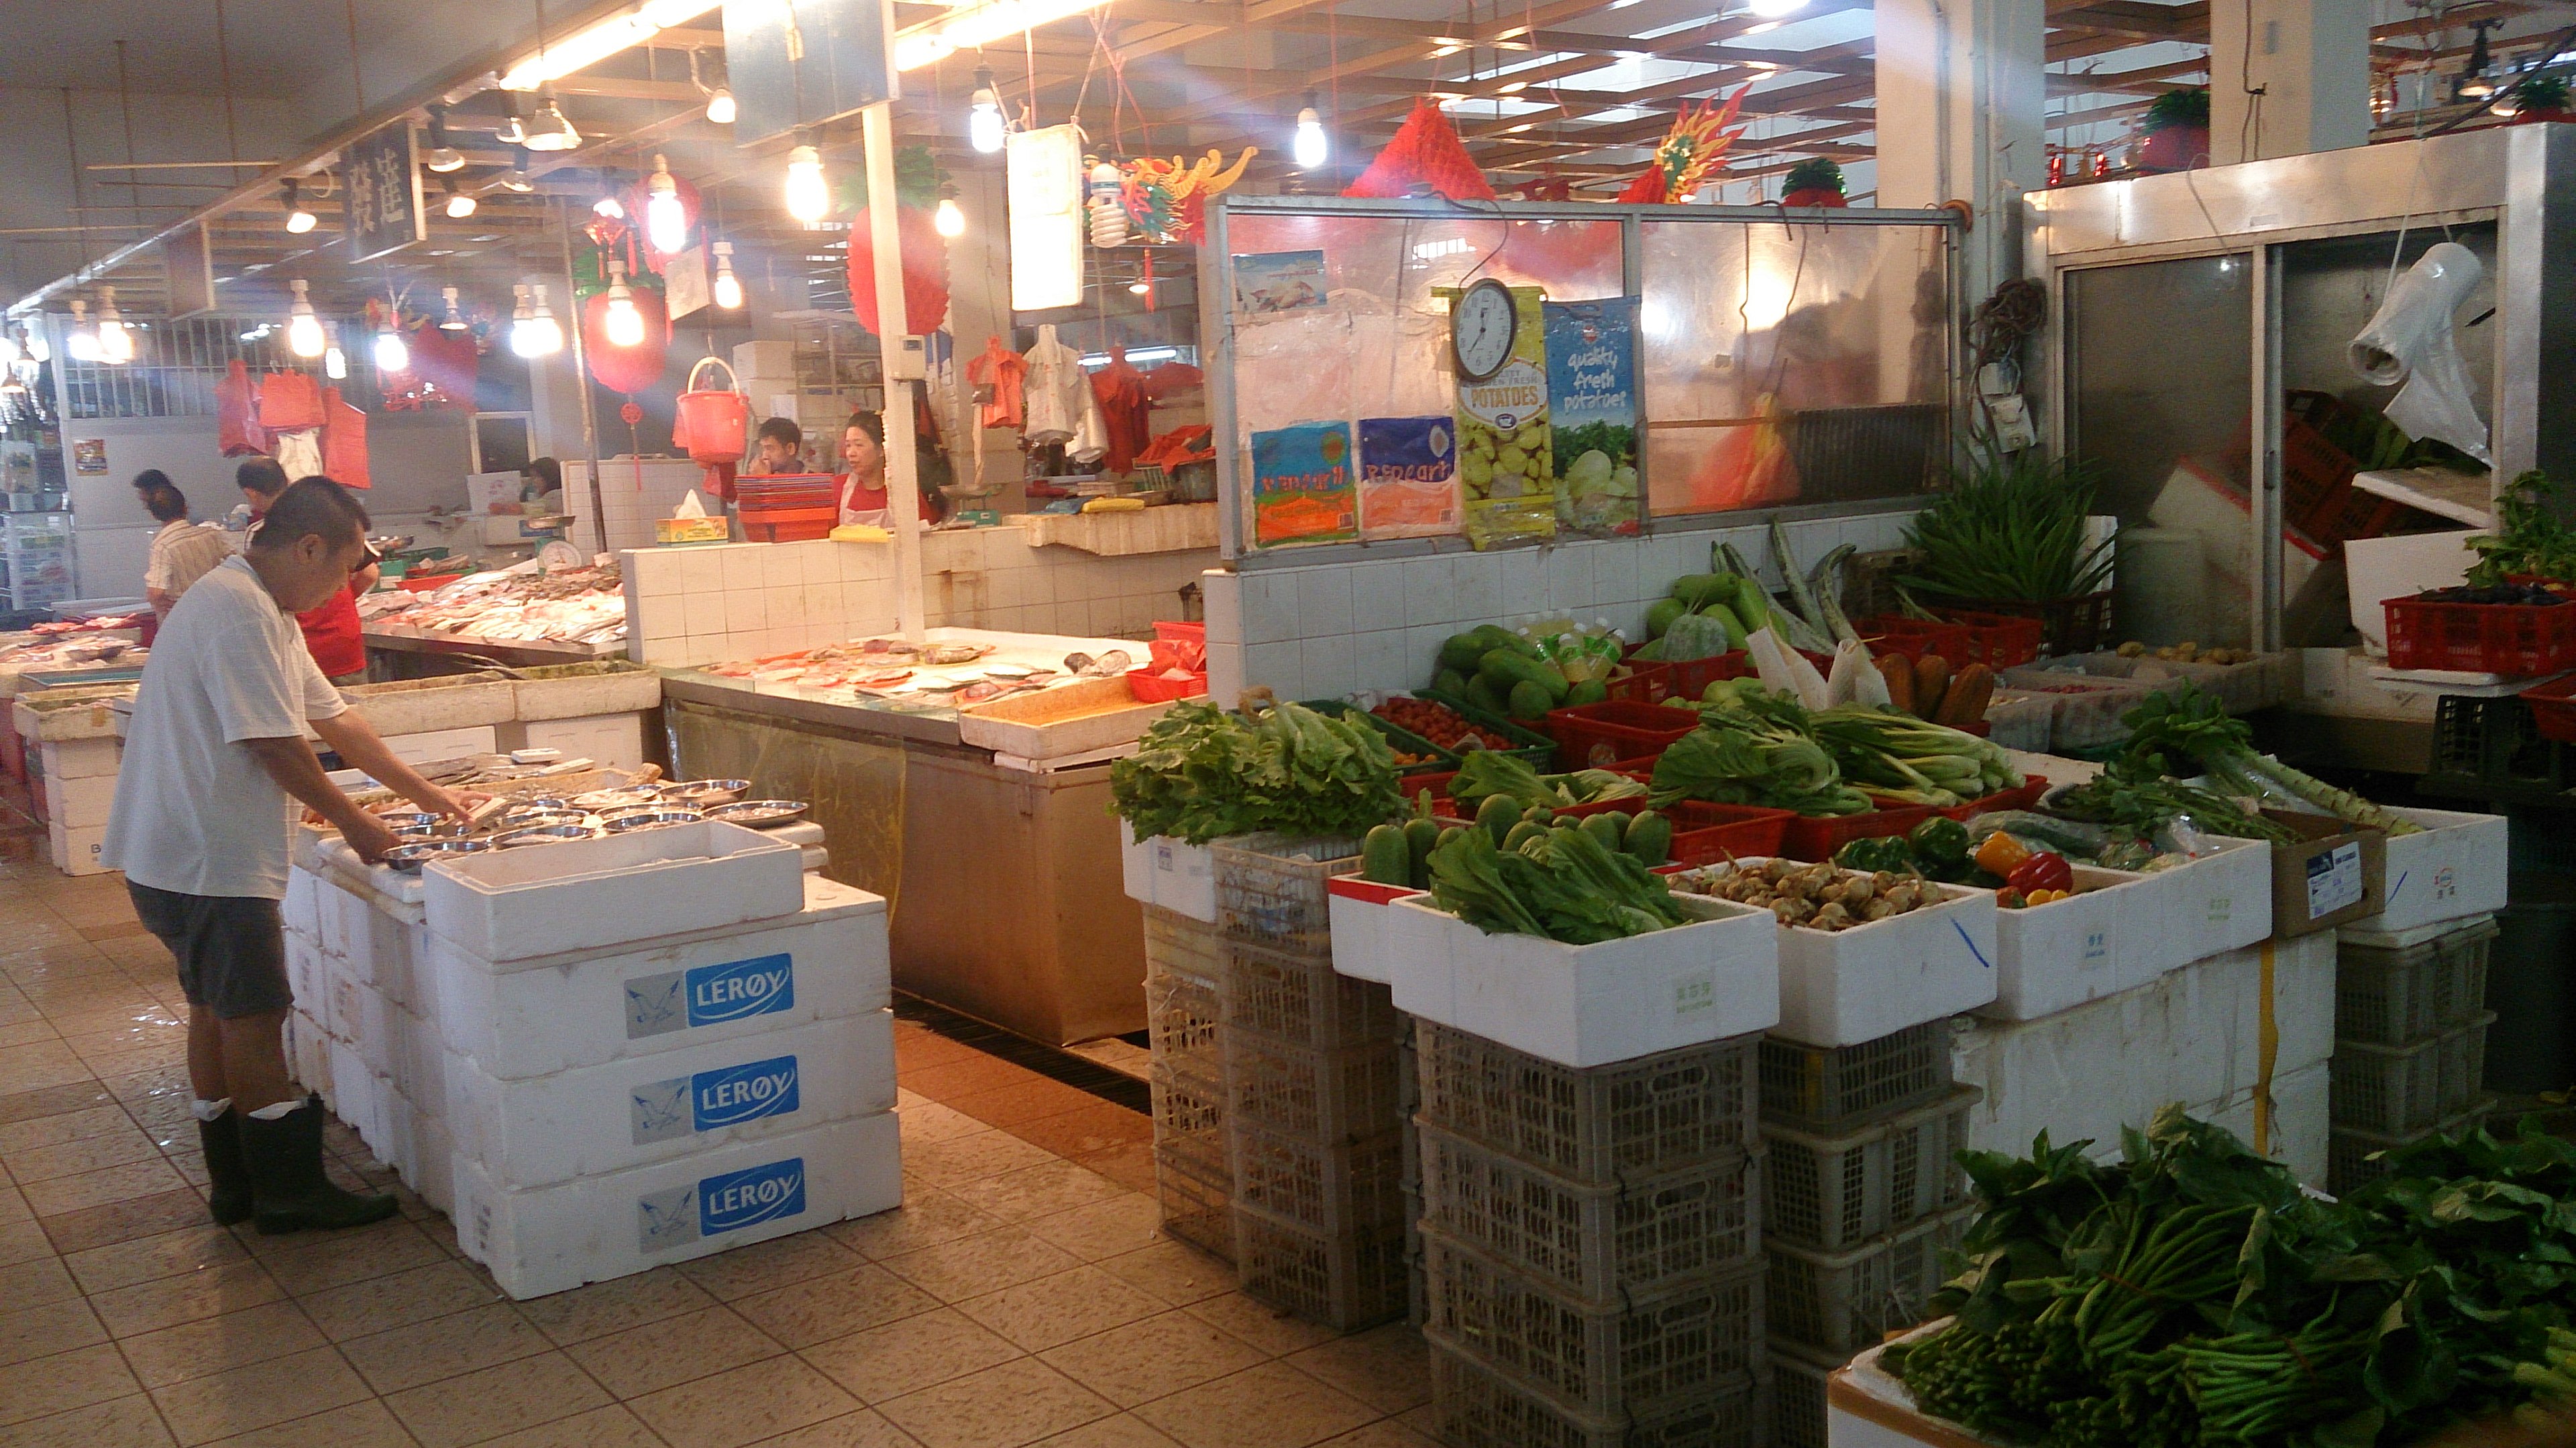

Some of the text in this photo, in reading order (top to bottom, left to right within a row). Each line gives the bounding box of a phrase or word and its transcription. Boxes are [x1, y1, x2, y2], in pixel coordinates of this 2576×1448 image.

[1567, 345, 1618, 372] quality
[1573, 368, 1615, 390] fresh
[1470, 385, 1539, 408] POTATOES
[1563, 389, 1627, 414] potatoes
[696, 968, 784, 1007] LERØY
[702, 1072, 788, 1110] LERØY
[709, 1174, 794, 1215] LERØY
